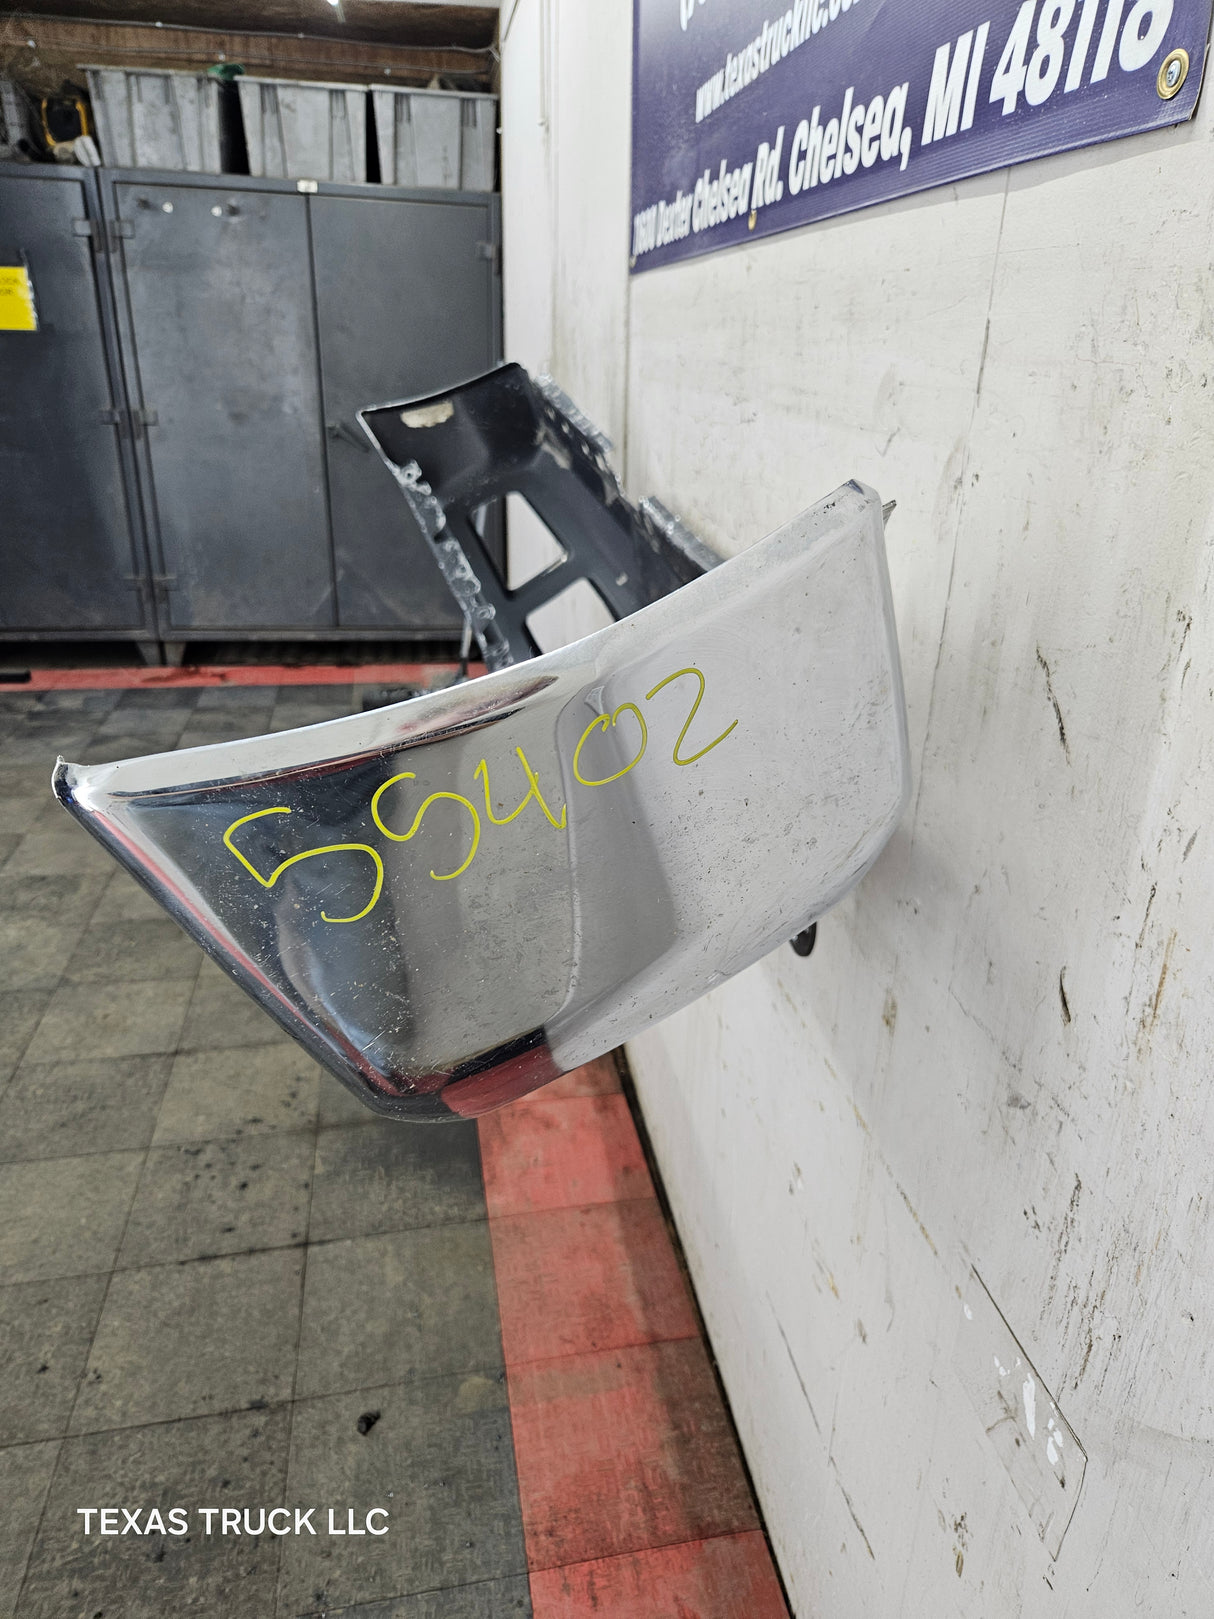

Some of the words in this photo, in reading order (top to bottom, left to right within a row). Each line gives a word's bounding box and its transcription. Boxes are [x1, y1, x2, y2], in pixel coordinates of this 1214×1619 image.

[692, 159, 754, 234] Chelsea
[750, 126, 785, 210] Rd.
[788, 81, 912, 196] Chelsea,
[921, 20, 991, 147] MI
